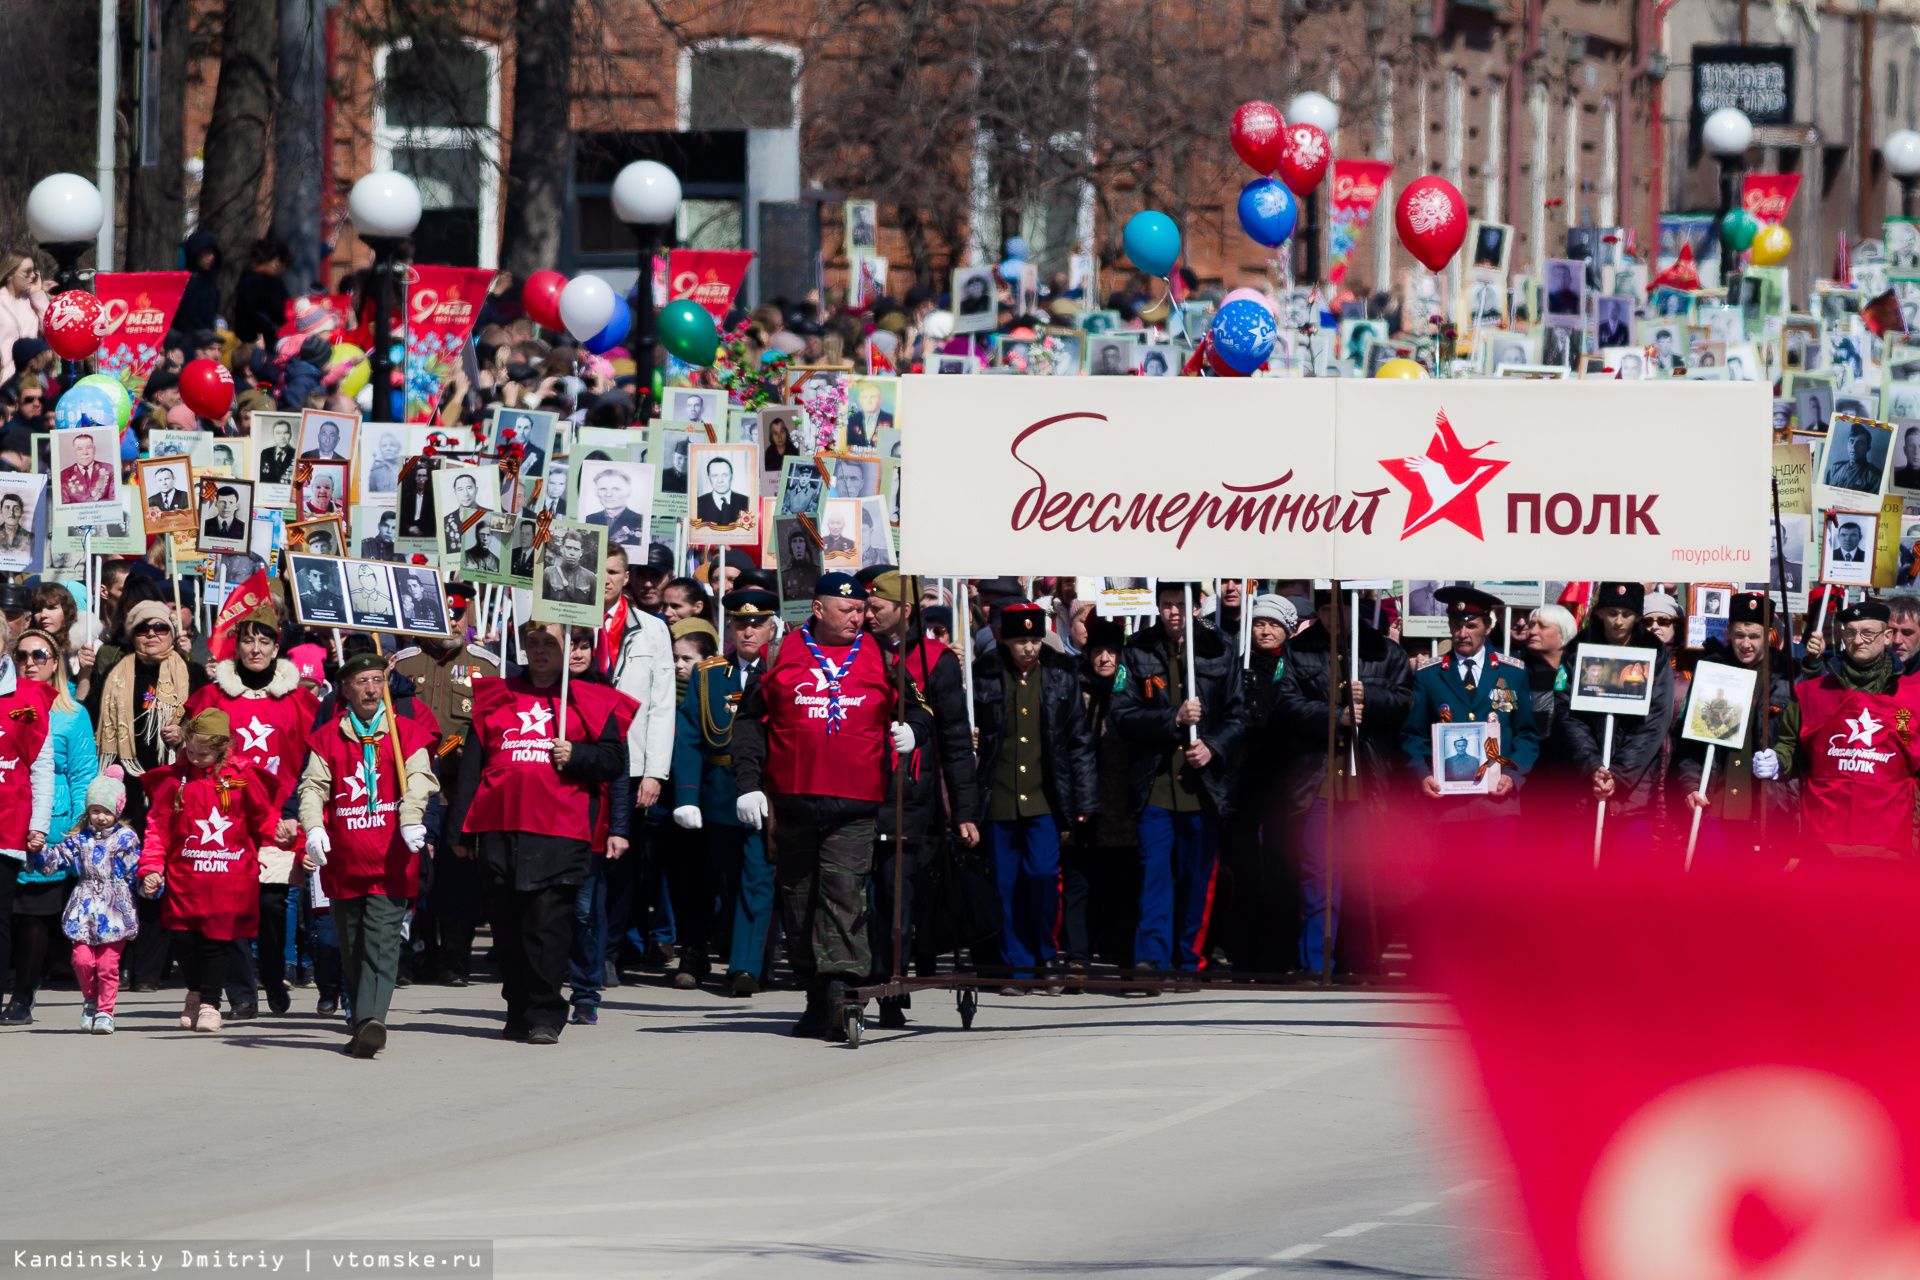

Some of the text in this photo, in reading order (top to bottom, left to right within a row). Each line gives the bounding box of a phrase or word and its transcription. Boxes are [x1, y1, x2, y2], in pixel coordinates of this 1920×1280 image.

[1295, 129, 1312, 147] 9
[673, 271, 699, 301] 9
[411, 289, 472, 324] 9 мая
[103, 299, 165, 337] 9 мая
[1011, 411, 1660, 550] бессмертный ПОЛК
[1671, 545, 1751, 566] moypolk.ru
[808, 706, 847, 720] ПОК
[501, 728, 556, 751] бессмертн
[511, 749, 551, 764] ПОЛК
[1838, 759, 1875, 774] ПОЛК
[346, 814, 387, 830] ПОЛК
[193, 860, 229, 872] ПОЛК
